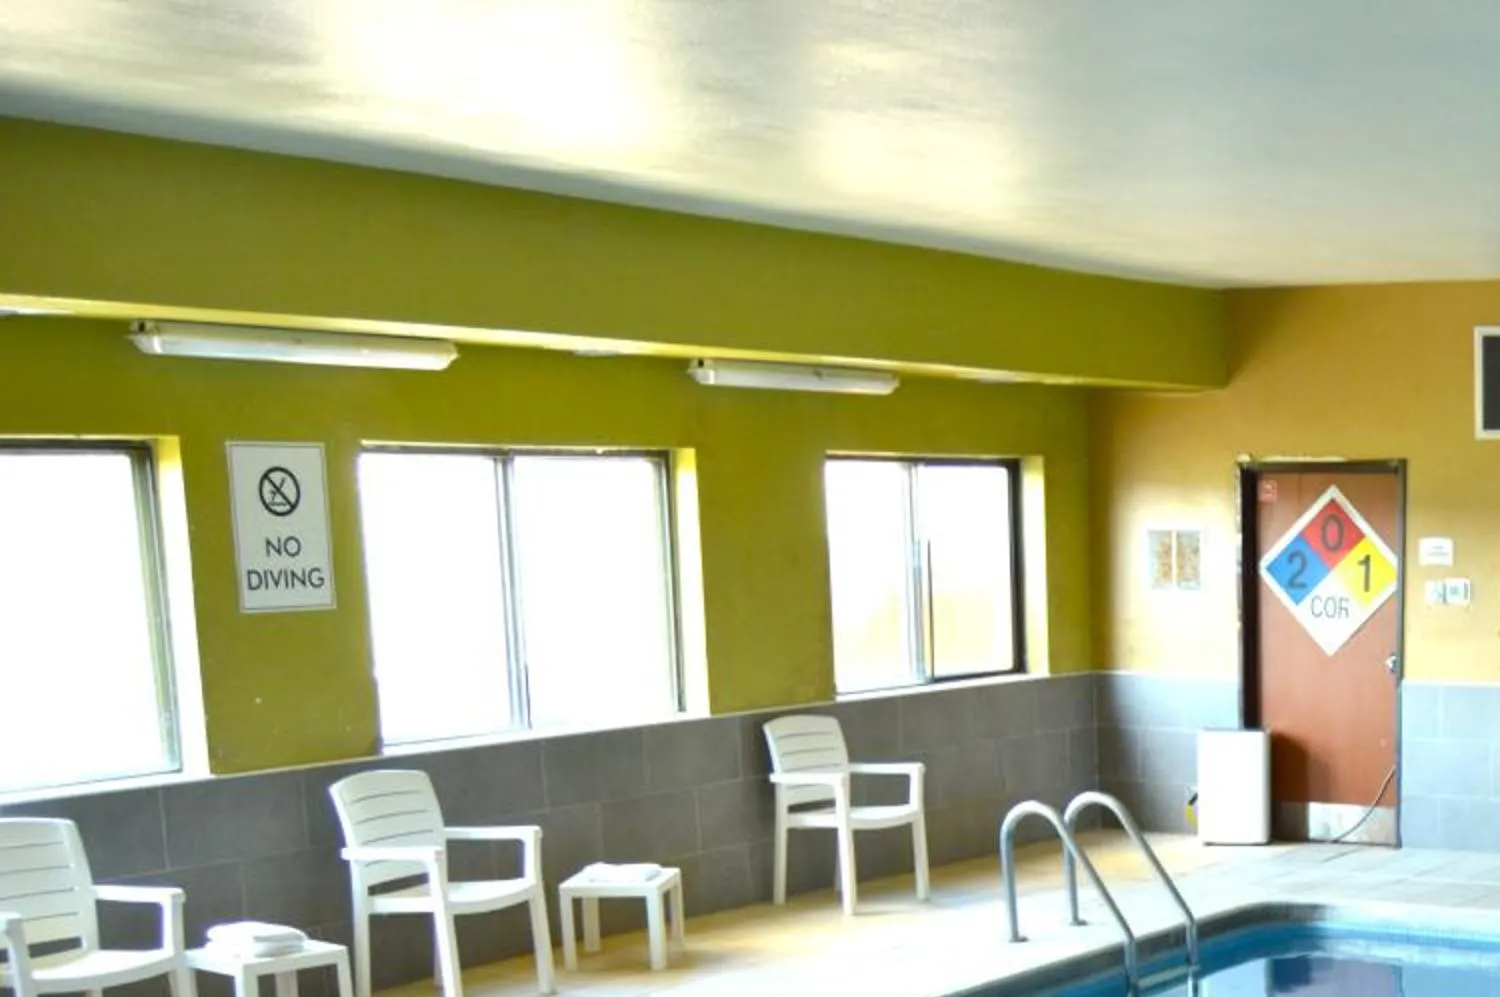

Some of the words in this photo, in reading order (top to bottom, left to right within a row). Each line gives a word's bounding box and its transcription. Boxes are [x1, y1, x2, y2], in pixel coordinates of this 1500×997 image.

[265, 535, 302, 558] NO
[1321, 513, 1344, 552] 0
[247, 567, 325, 591] DIVING
[1286, 550, 1308, 589] 2
[1357, 554, 1371, 592] 1
[1310, 595, 1350, 619] COR
